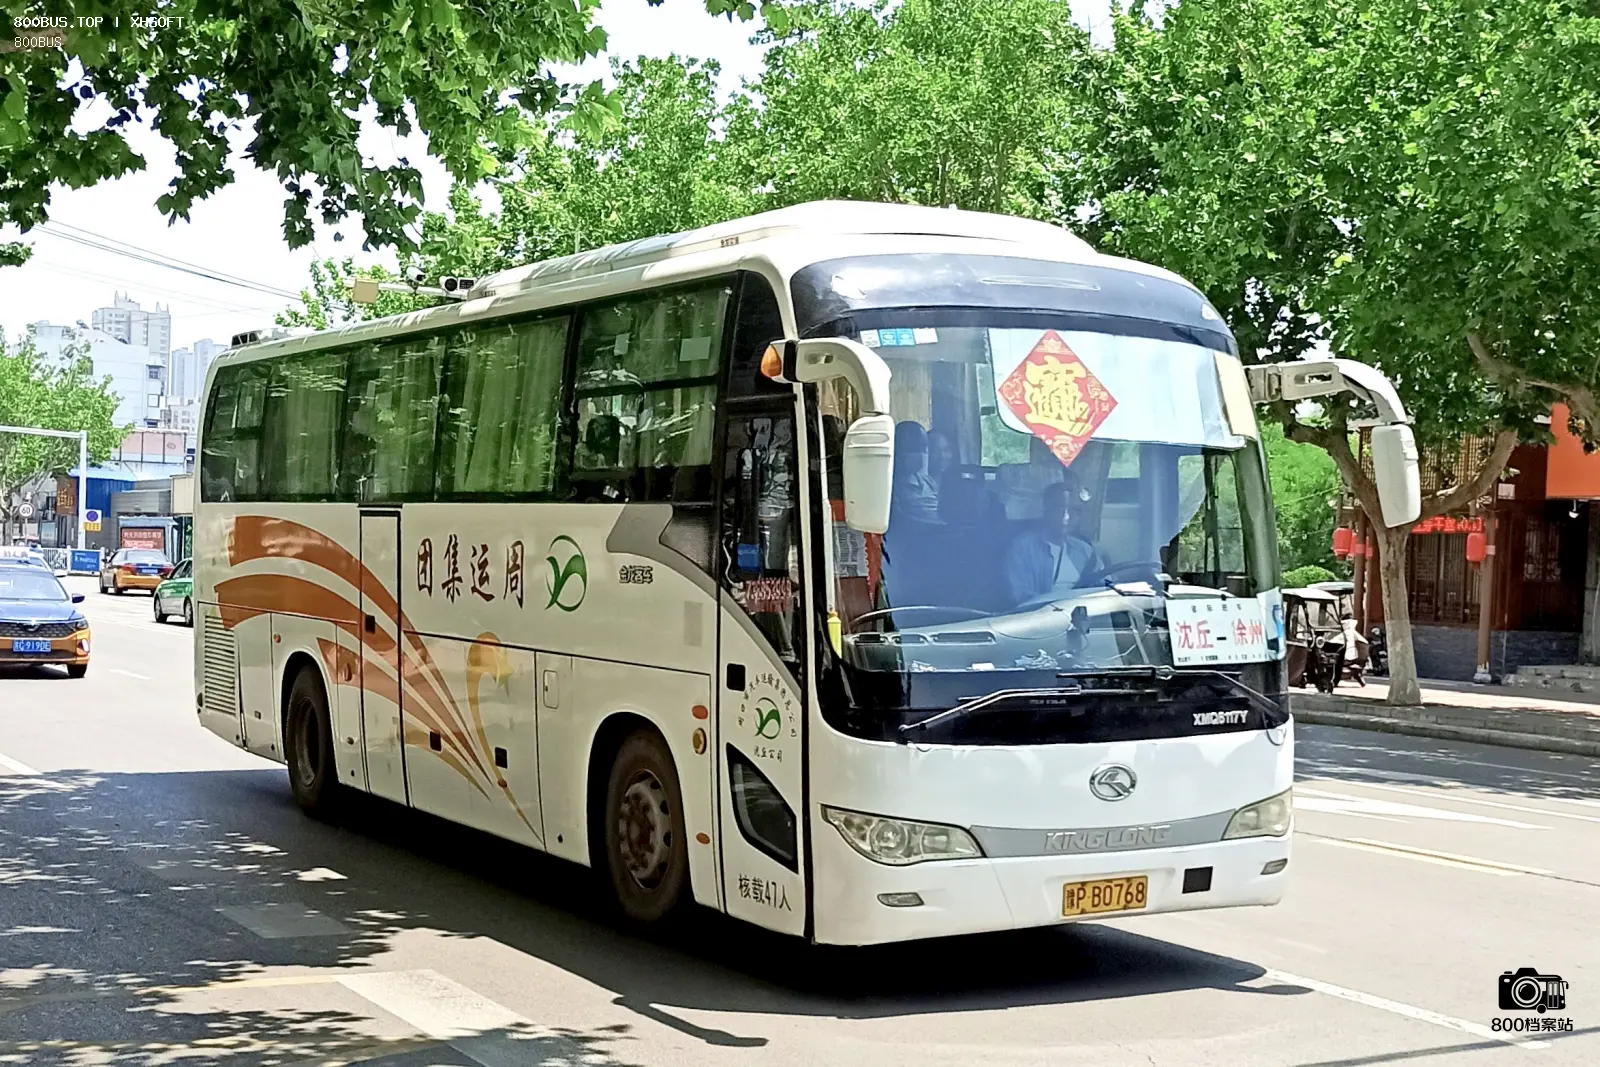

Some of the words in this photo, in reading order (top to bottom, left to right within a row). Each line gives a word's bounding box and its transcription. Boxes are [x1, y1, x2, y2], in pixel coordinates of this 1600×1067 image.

[1192, 709, 1249, 726] XMQ6117Y
[738, 873, 792, 912] 核载47人
